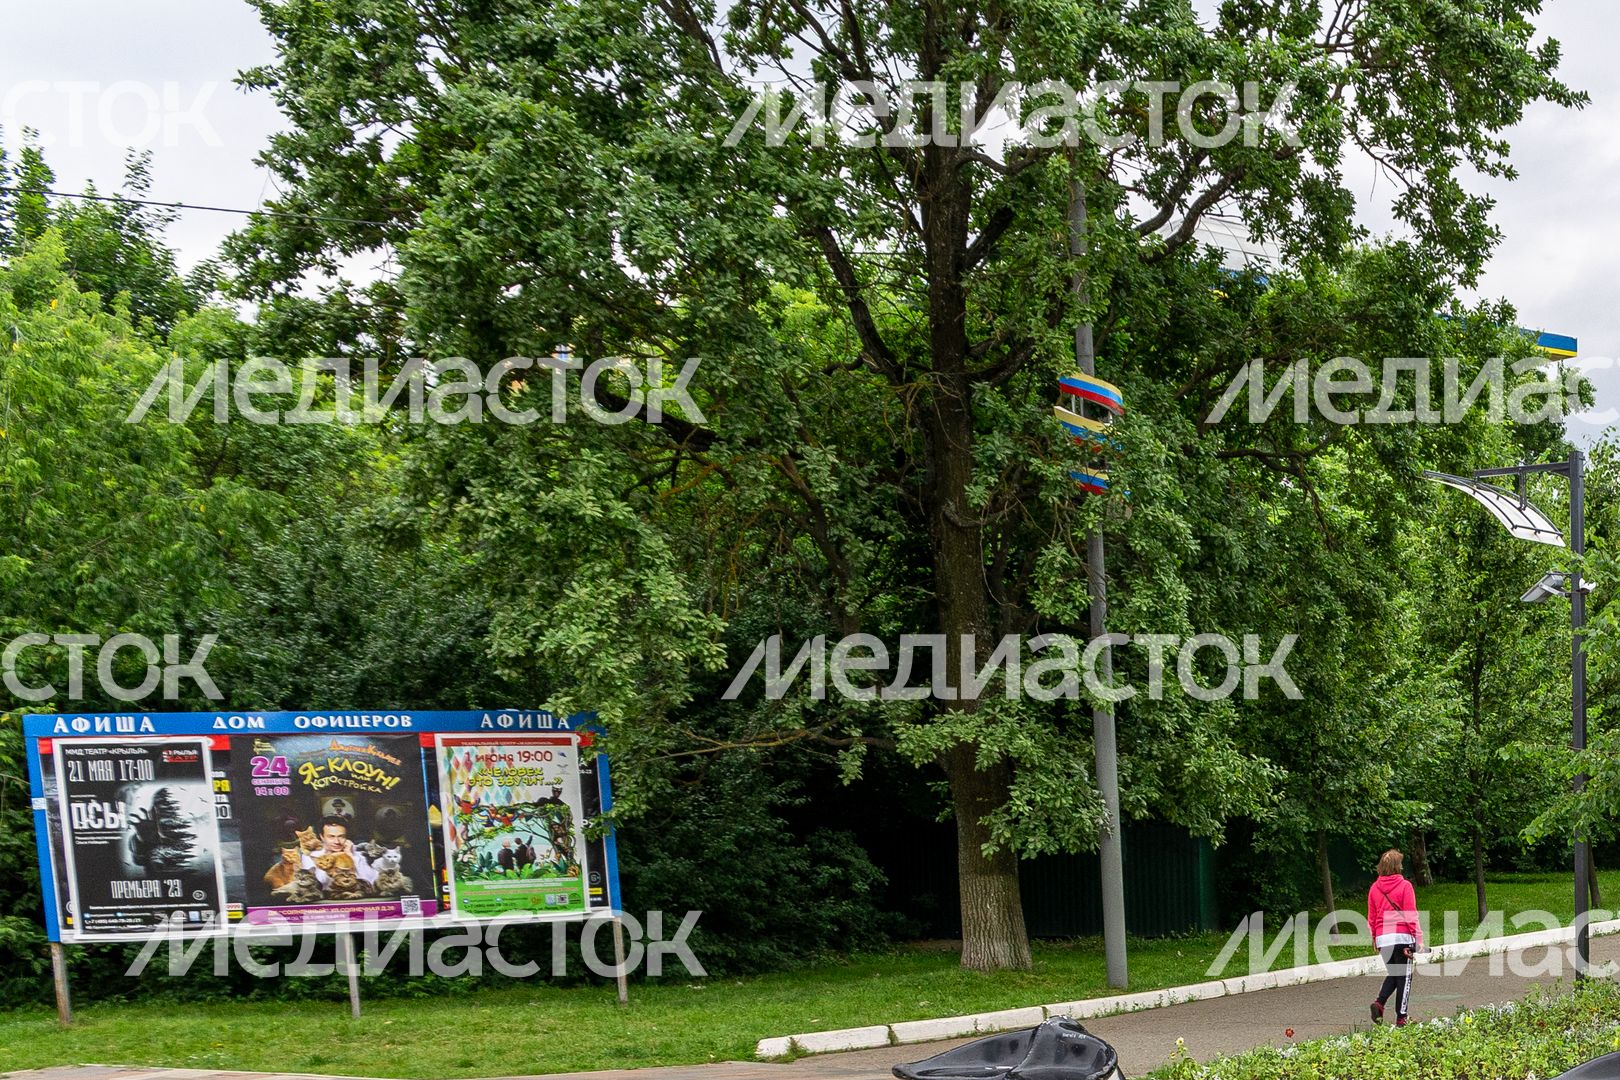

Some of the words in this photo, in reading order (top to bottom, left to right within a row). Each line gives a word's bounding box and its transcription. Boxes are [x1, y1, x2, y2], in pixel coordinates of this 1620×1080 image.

[53, 716, 156, 734] АФИША
[212, 716, 266, 730] ДОМ
[293, 715, 413, 729] ОФИЦЕРОВ
[480, 713, 571, 730] АФИША
[250, 756, 290, 777] 24
[517, 750, 553, 762] 19:00
[68, 760, 84, 783] 21
[88, 759, 115, 783] МАЯ
[119, 758, 155, 782] 17:00
[110, 879, 163, 899] ПРЕМЬЕРА
